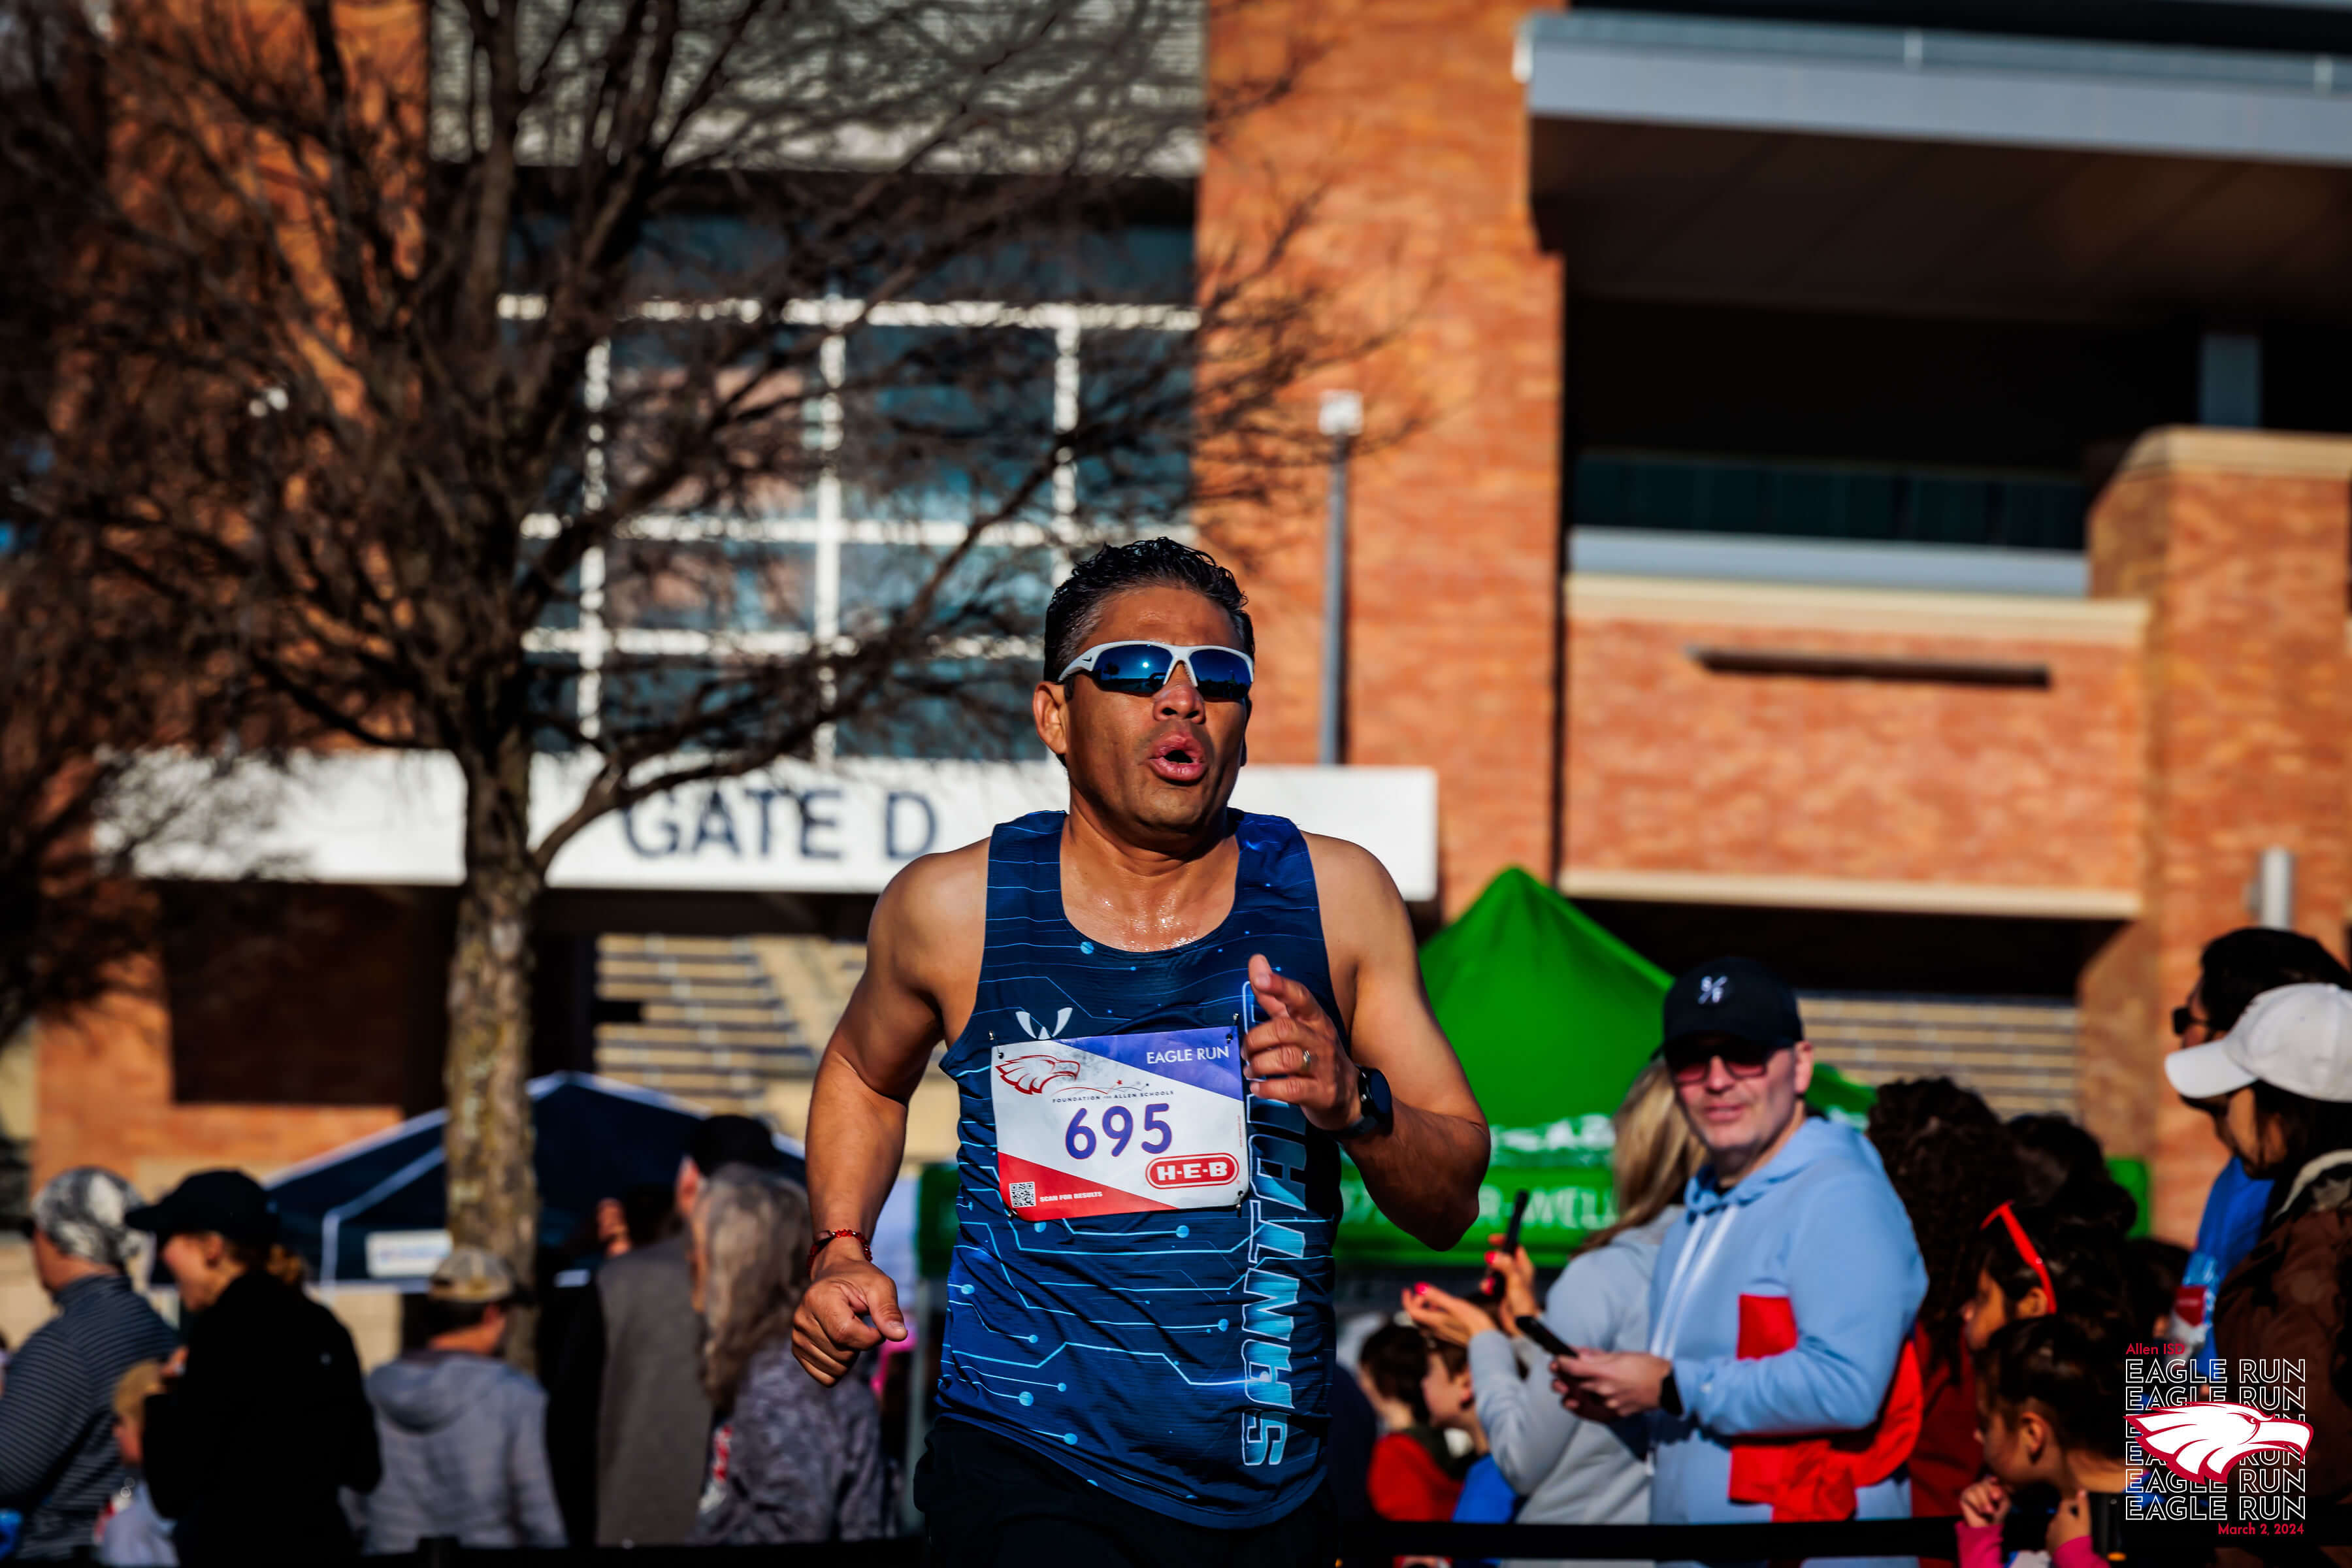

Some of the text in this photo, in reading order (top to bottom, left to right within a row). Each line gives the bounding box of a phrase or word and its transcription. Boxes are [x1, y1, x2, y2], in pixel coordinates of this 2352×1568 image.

[621, 787, 938, 860] GATE D
[1146, 1045, 1230, 1064] EAGLE RUN
[1065, 1103, 1173, 1160] 695
[1073, 1191, 1103, 1200] RESULTS
[1241, 981, 1307, 1466] SANTA
